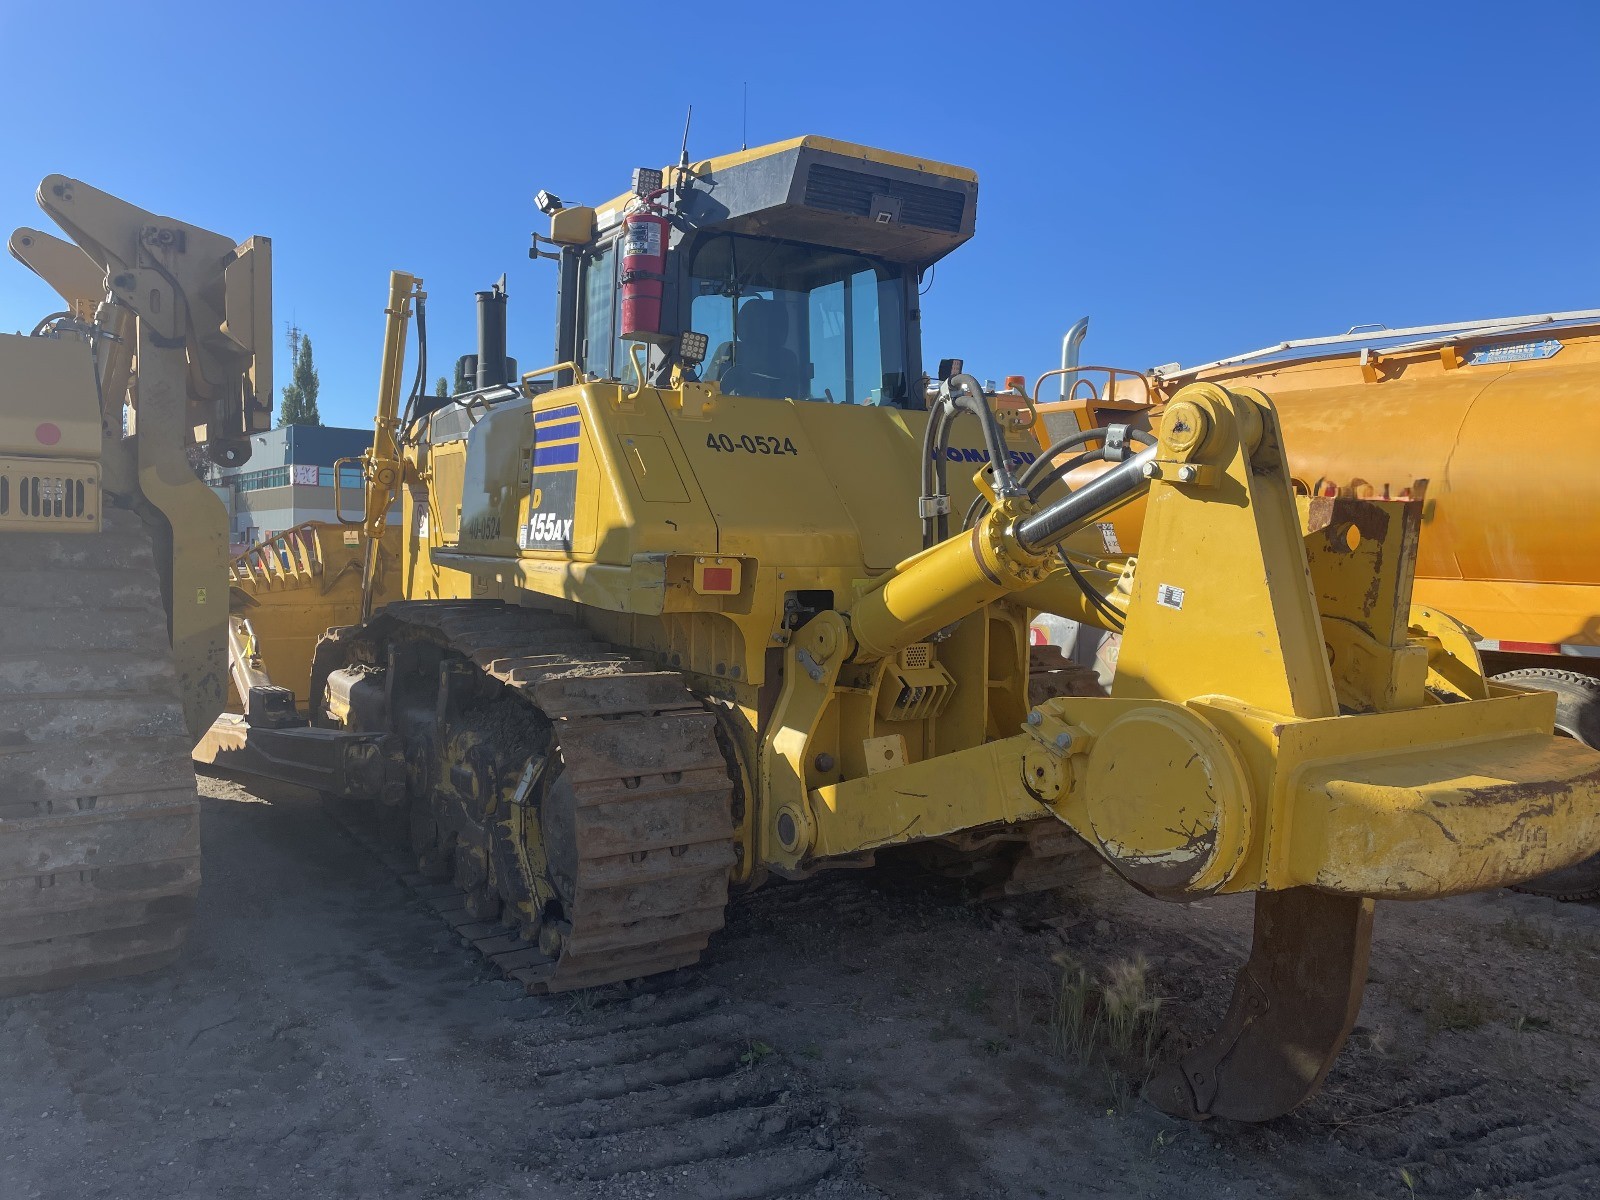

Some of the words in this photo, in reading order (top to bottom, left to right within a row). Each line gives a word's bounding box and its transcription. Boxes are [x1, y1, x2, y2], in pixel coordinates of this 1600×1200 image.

[706, 432, 798, 456] 40-0524
[532, 488, 542, 509] D
[469, 515, 501, 540] 40-0524
[529, 512, 573, 541] 155AX
